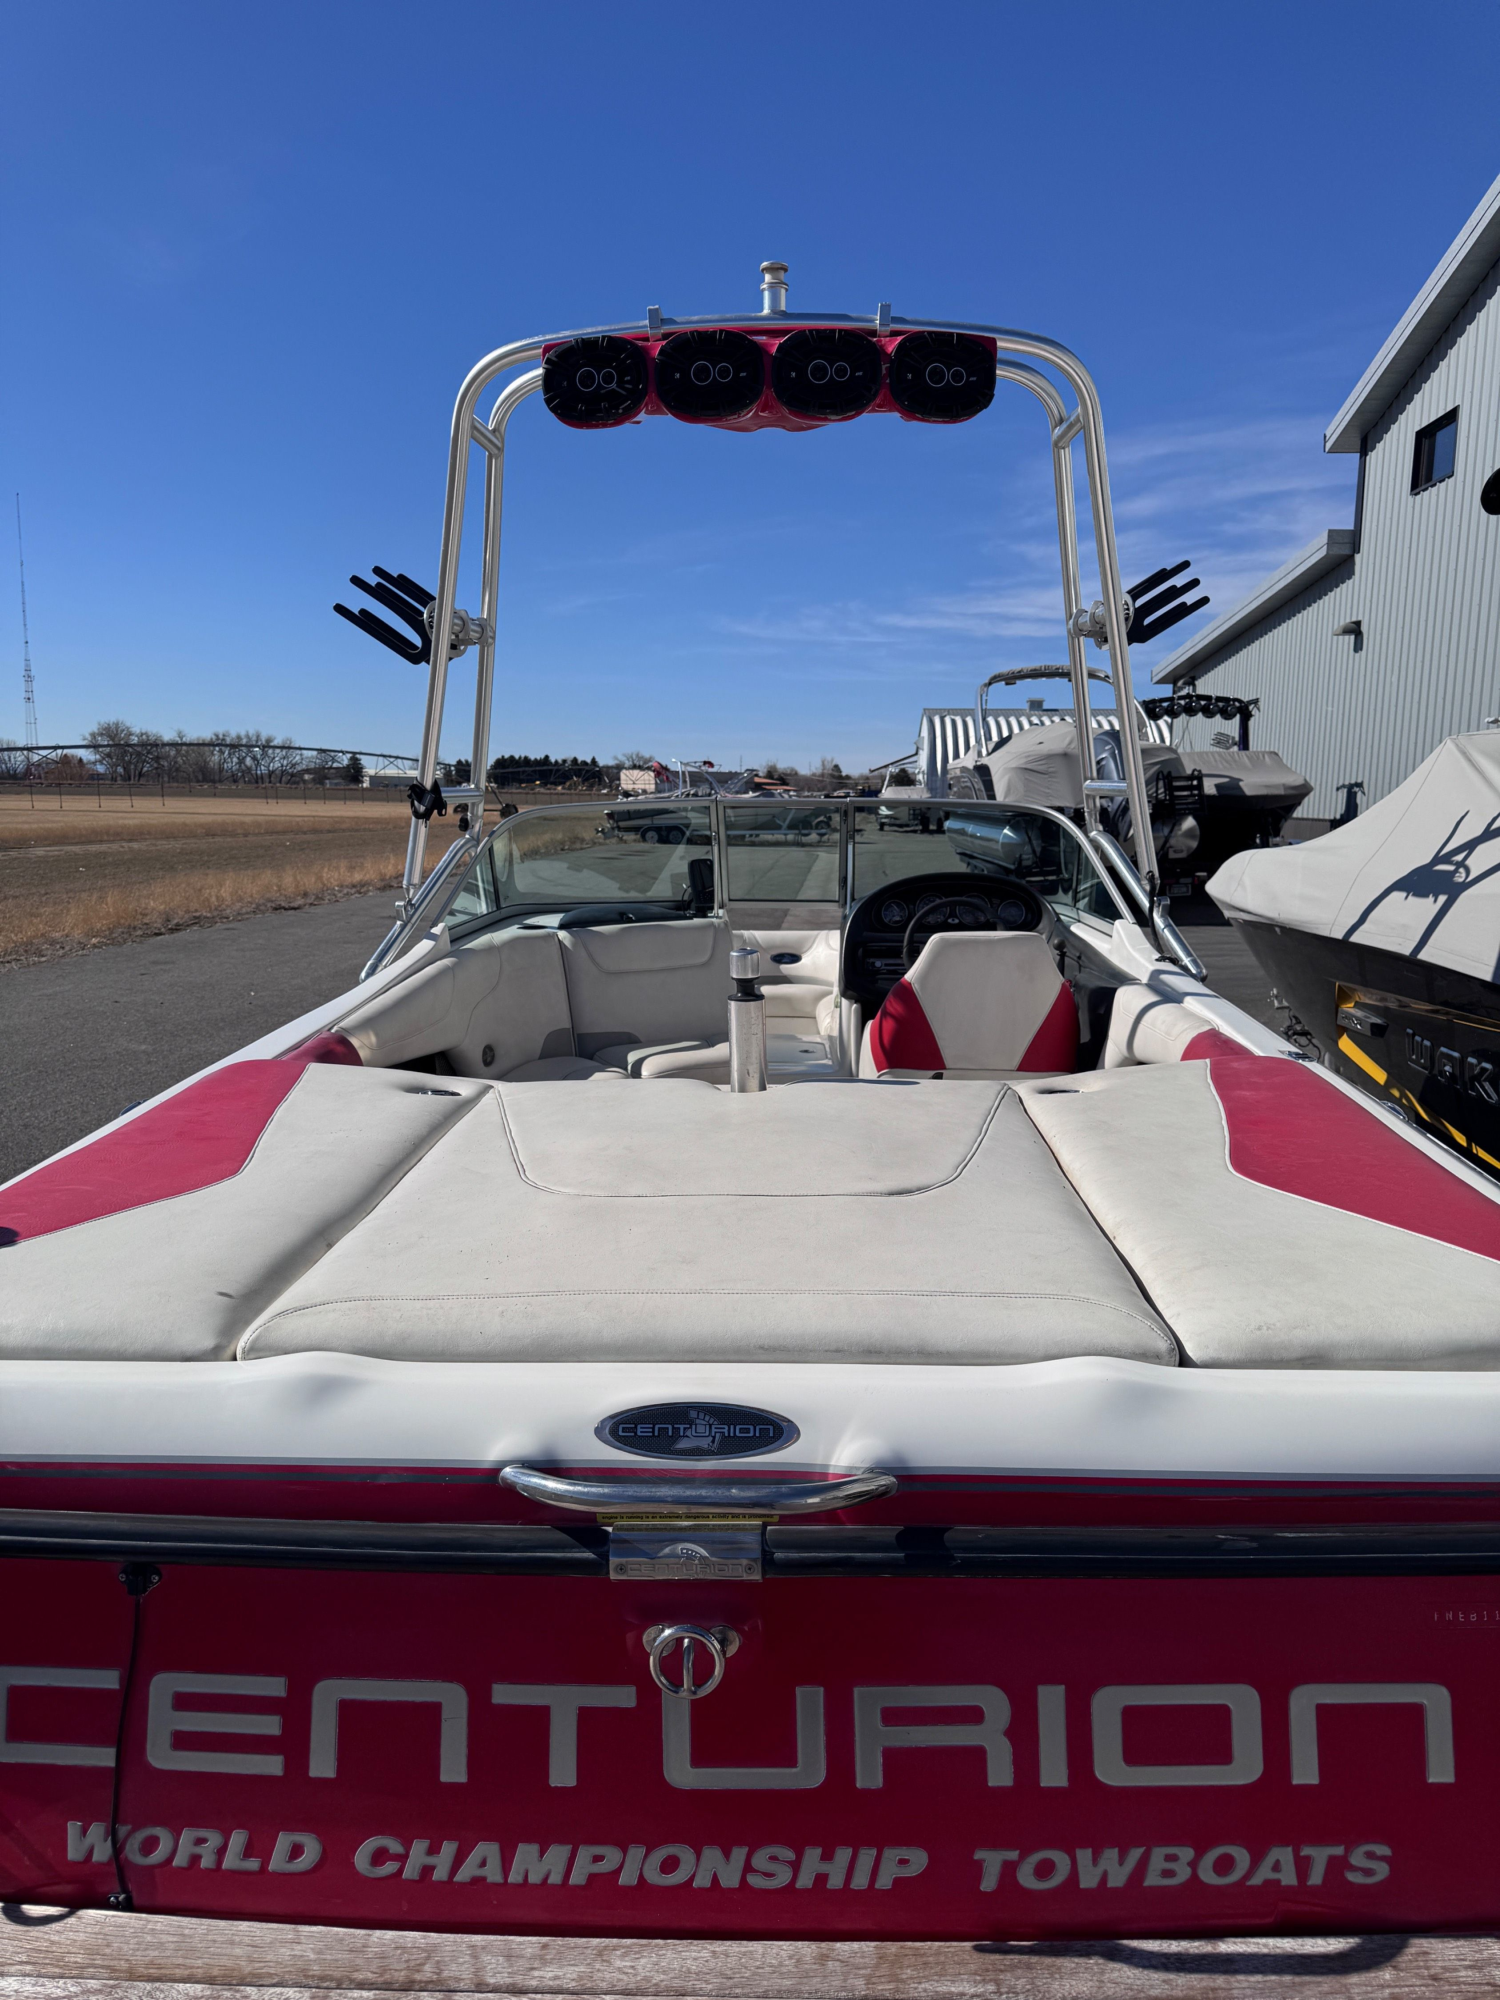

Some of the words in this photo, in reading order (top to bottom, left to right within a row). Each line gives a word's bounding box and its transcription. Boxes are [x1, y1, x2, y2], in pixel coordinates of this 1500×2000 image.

[617, 1423, 775, 1438] CENTURION
[627, 1563, 744, 1574] CENTURION
[0, 1665, 1455, 1789] CENTURION
[66, 1820, 323, 1874] WORLD
[353, 1835, 929, 1890] CHAMPIONSHIP
[972, 1843, 1393, 1892] TOWBOATS
